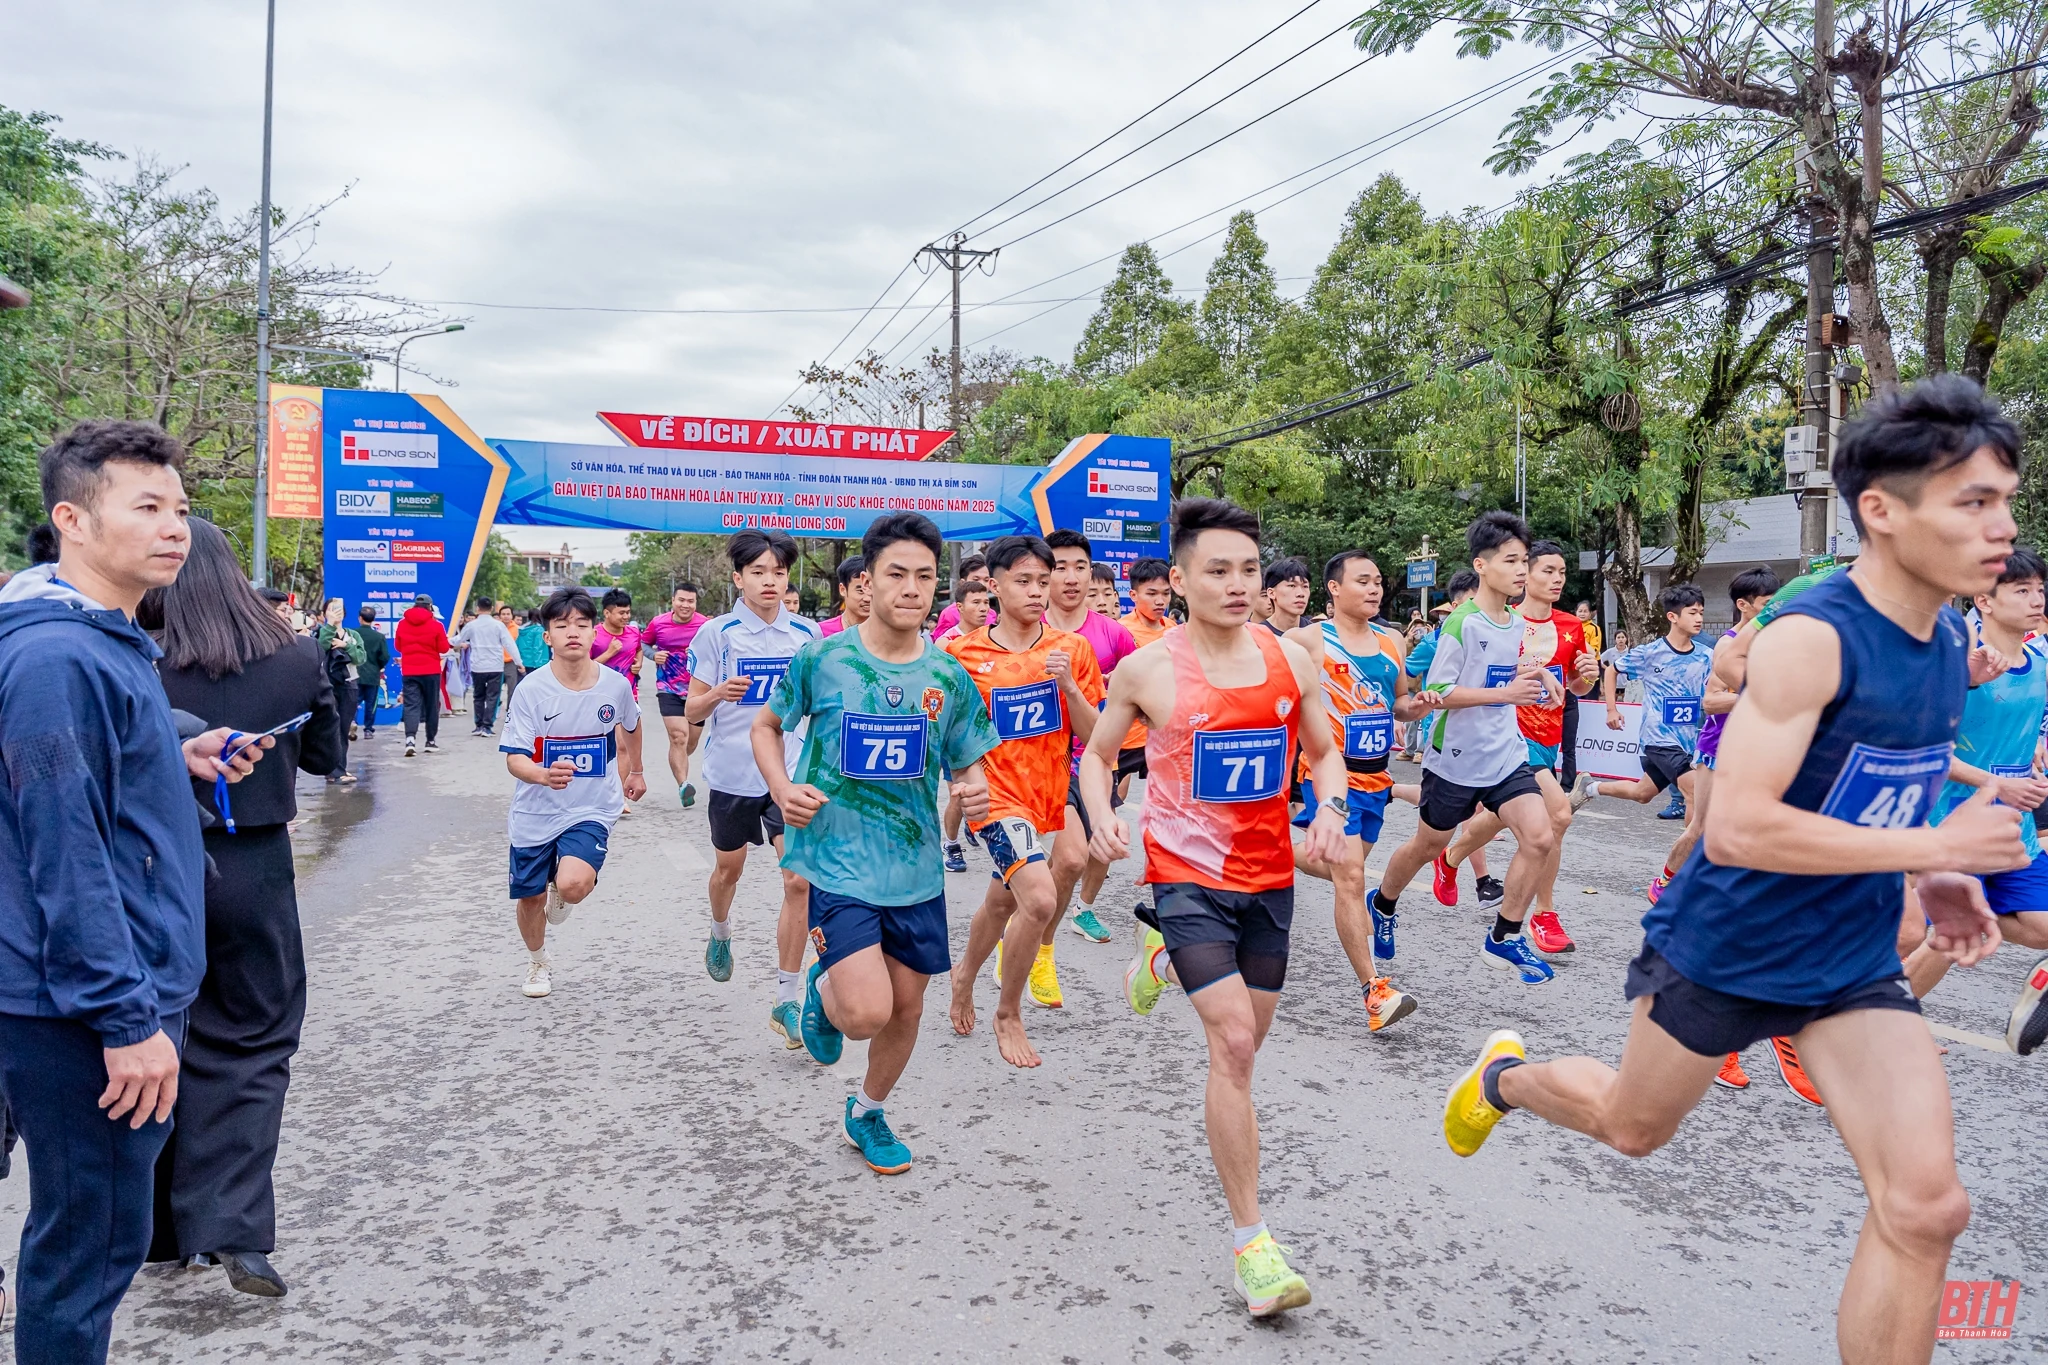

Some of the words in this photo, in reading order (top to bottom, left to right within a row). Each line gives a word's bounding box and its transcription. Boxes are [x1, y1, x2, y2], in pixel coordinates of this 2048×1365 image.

[639, 415, 675, 441] VỀ
[682, 419, 750, 445] ĐÍCH
[775, 424, 845, 450] XUẤT
[852, 431, 920, 454] PHÁT
[370, 449, 407, 458] LONG
[409, 451, 437, 459] SON
[605, 463, 626, 474] HÓA,
[647, 466, 669, 476] THAO
[671, 465, 682, 477] VÀ
[684, 468, 696, 477] DU
[698, 468, 717, 480] LỊCH
[725, 468, 742, 480] BÁO
[744, 470, 772, 481] THANH
[773, 471, 791, 481] HÓA
[843, 475, 870, 485] THANH
[871, 475, 888, 486] HÓA
[894, 477, 917, 487] UBND
[918, 478, 931, 489] THỊ
[554, 477, 577, 496] GIẢI
[580, 481, 604, 500] VIỆT
[625, 483, 647, 500] BÁO
[650, 486, 686, 502] THANH
[689, 486, 711, 503] HÓA
[737, 488, 758, 505] THỨ
[760, 492, 785, 506] XXIX
[793, 493, 821, 510] CHẠY
[836, 492, 857, 509] SỨC
[859, 492, 885, 509] KHỎE
[972, 500, 996, 513] 2025
[1109, 483, 1135, 492] LONG
[1136, 485, 1156, 493] SON
[339, 493, 376, 507] BIDV
[396, 496, 432, 505] HABECO
[722, 511, 744, 527] CÚP
[747, 515, 758, 527] XI
[795, 516, 822, 530] LONG
[824, 516, 846, 530] SƠN
[1085, 521, 1112, 533] BIDV
[1126, 524, 1152, 532] HABECO
[340, 545, 378, 554] VietinBank
[401, 545, 443, 553] AGRIBANK
[367, 567, 416, 578] vinaphone
[1008, 701, 1046, 732] 72
[1672, 706, 1693, 723] 23
[1357, 728, 1387, 753] 45
[1576, 737, 1614, 752] LONG
[862, 737, 907, 771] 75
[1222, 755, 1266, 793] 71
[1856, 783, 1923, 829] 48
[1011, 822, 1033, 851] 7
